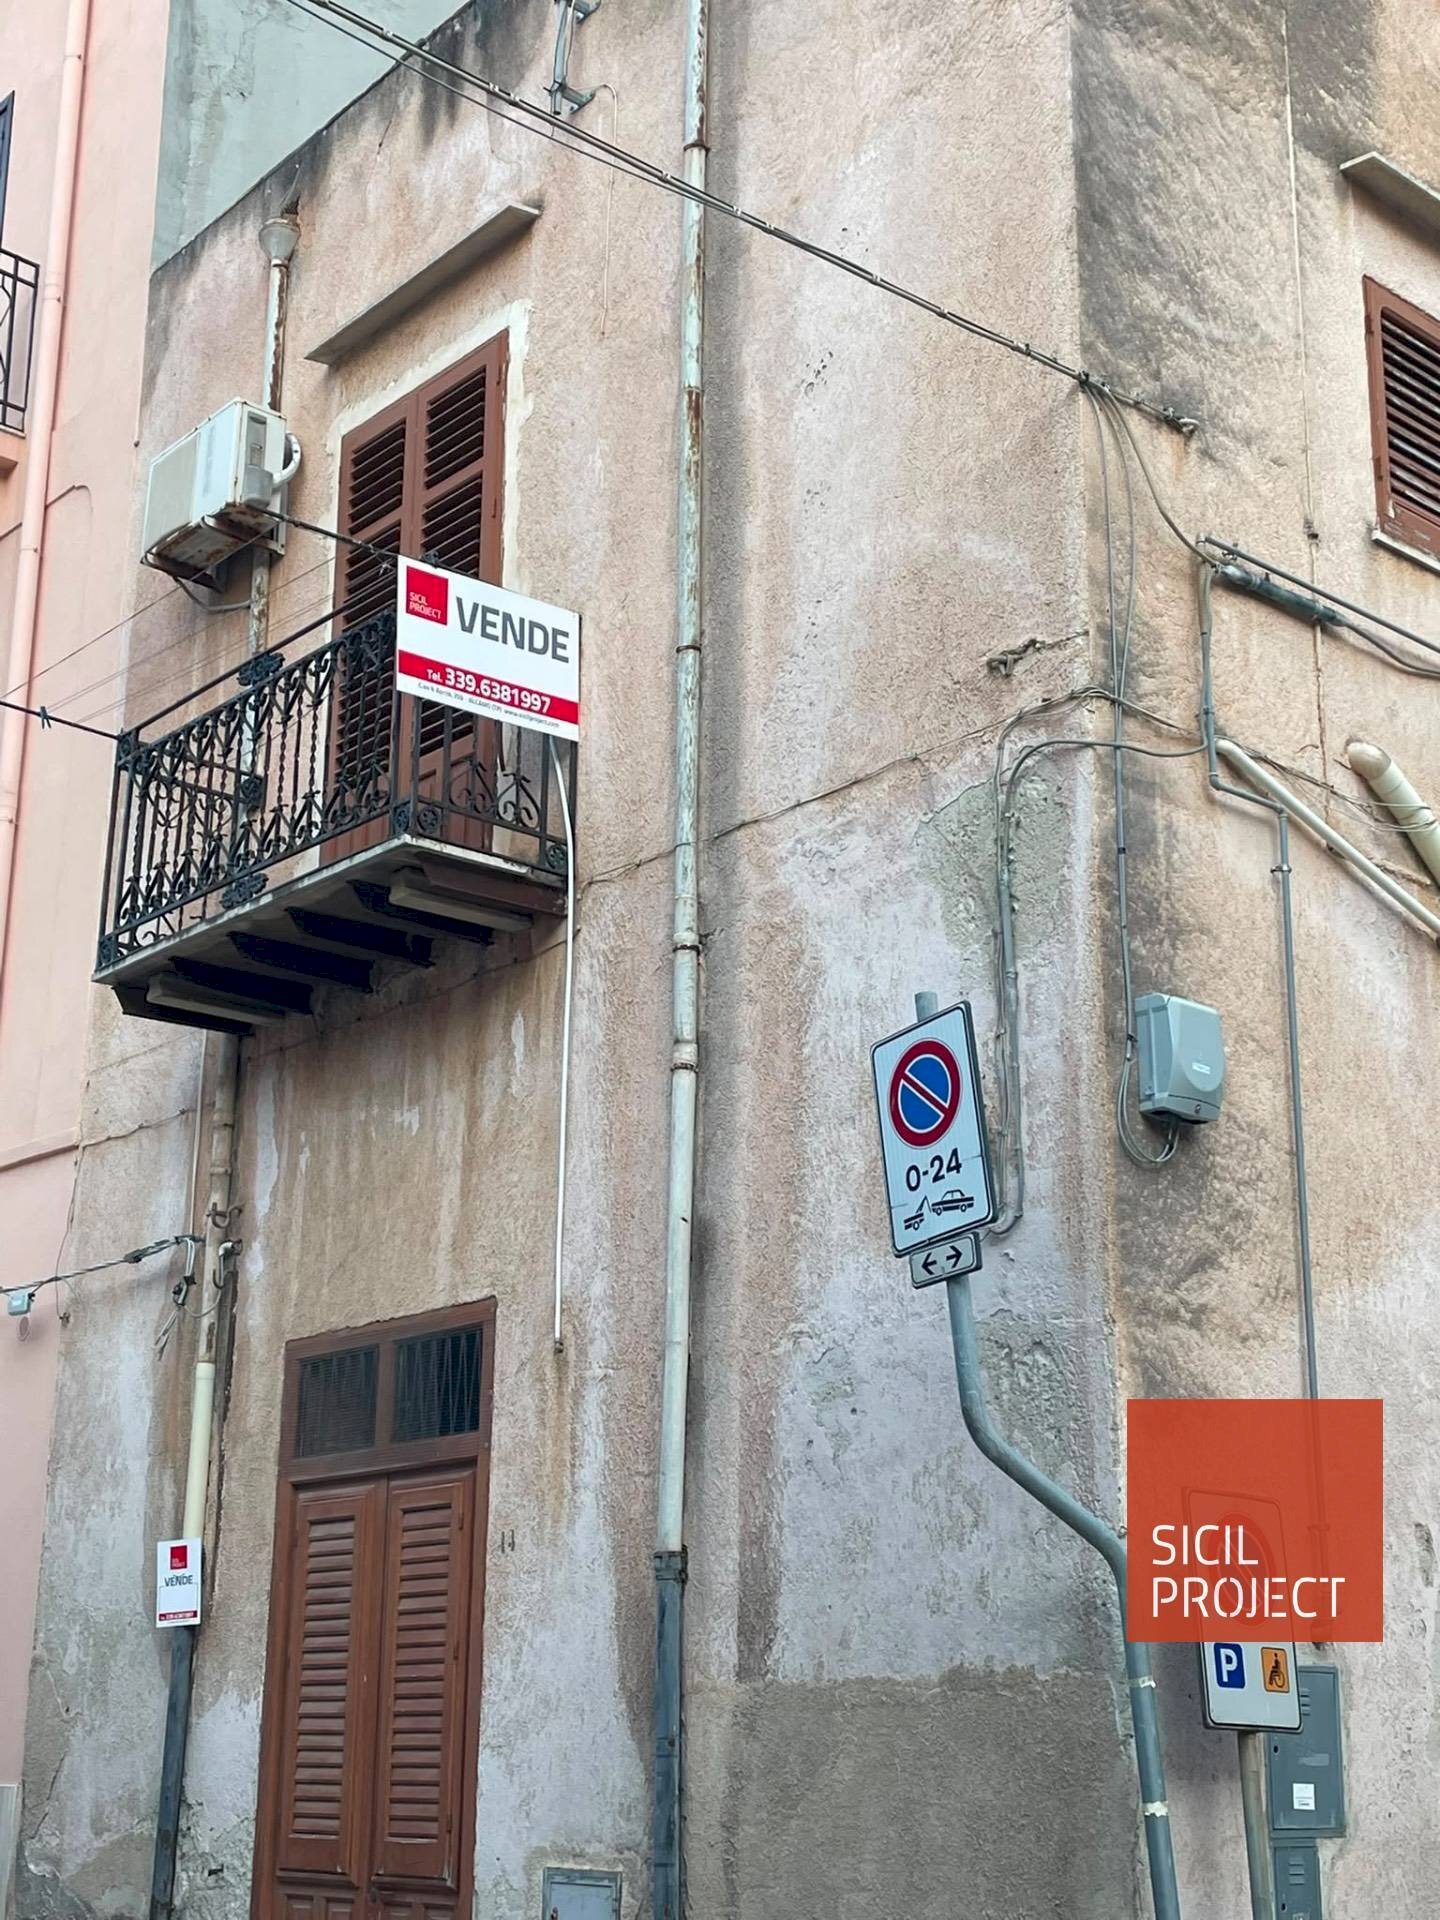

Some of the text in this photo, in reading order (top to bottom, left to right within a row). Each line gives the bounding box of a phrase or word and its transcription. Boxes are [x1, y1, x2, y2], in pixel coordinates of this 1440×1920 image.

[409, 601, 442, 620] PROJECT
[410, 591, 428, 606] SICIL
[456, 596, 570, 664] VENDE
[426, 668, 443, 683] Tel.
[445, 667, 551, 714] 339.6381997
[905, 1147, 963, 1192] 0-24
[164, 1574, 193, 1587] VENDE
[1220, 1648, 1238, 1683] P
